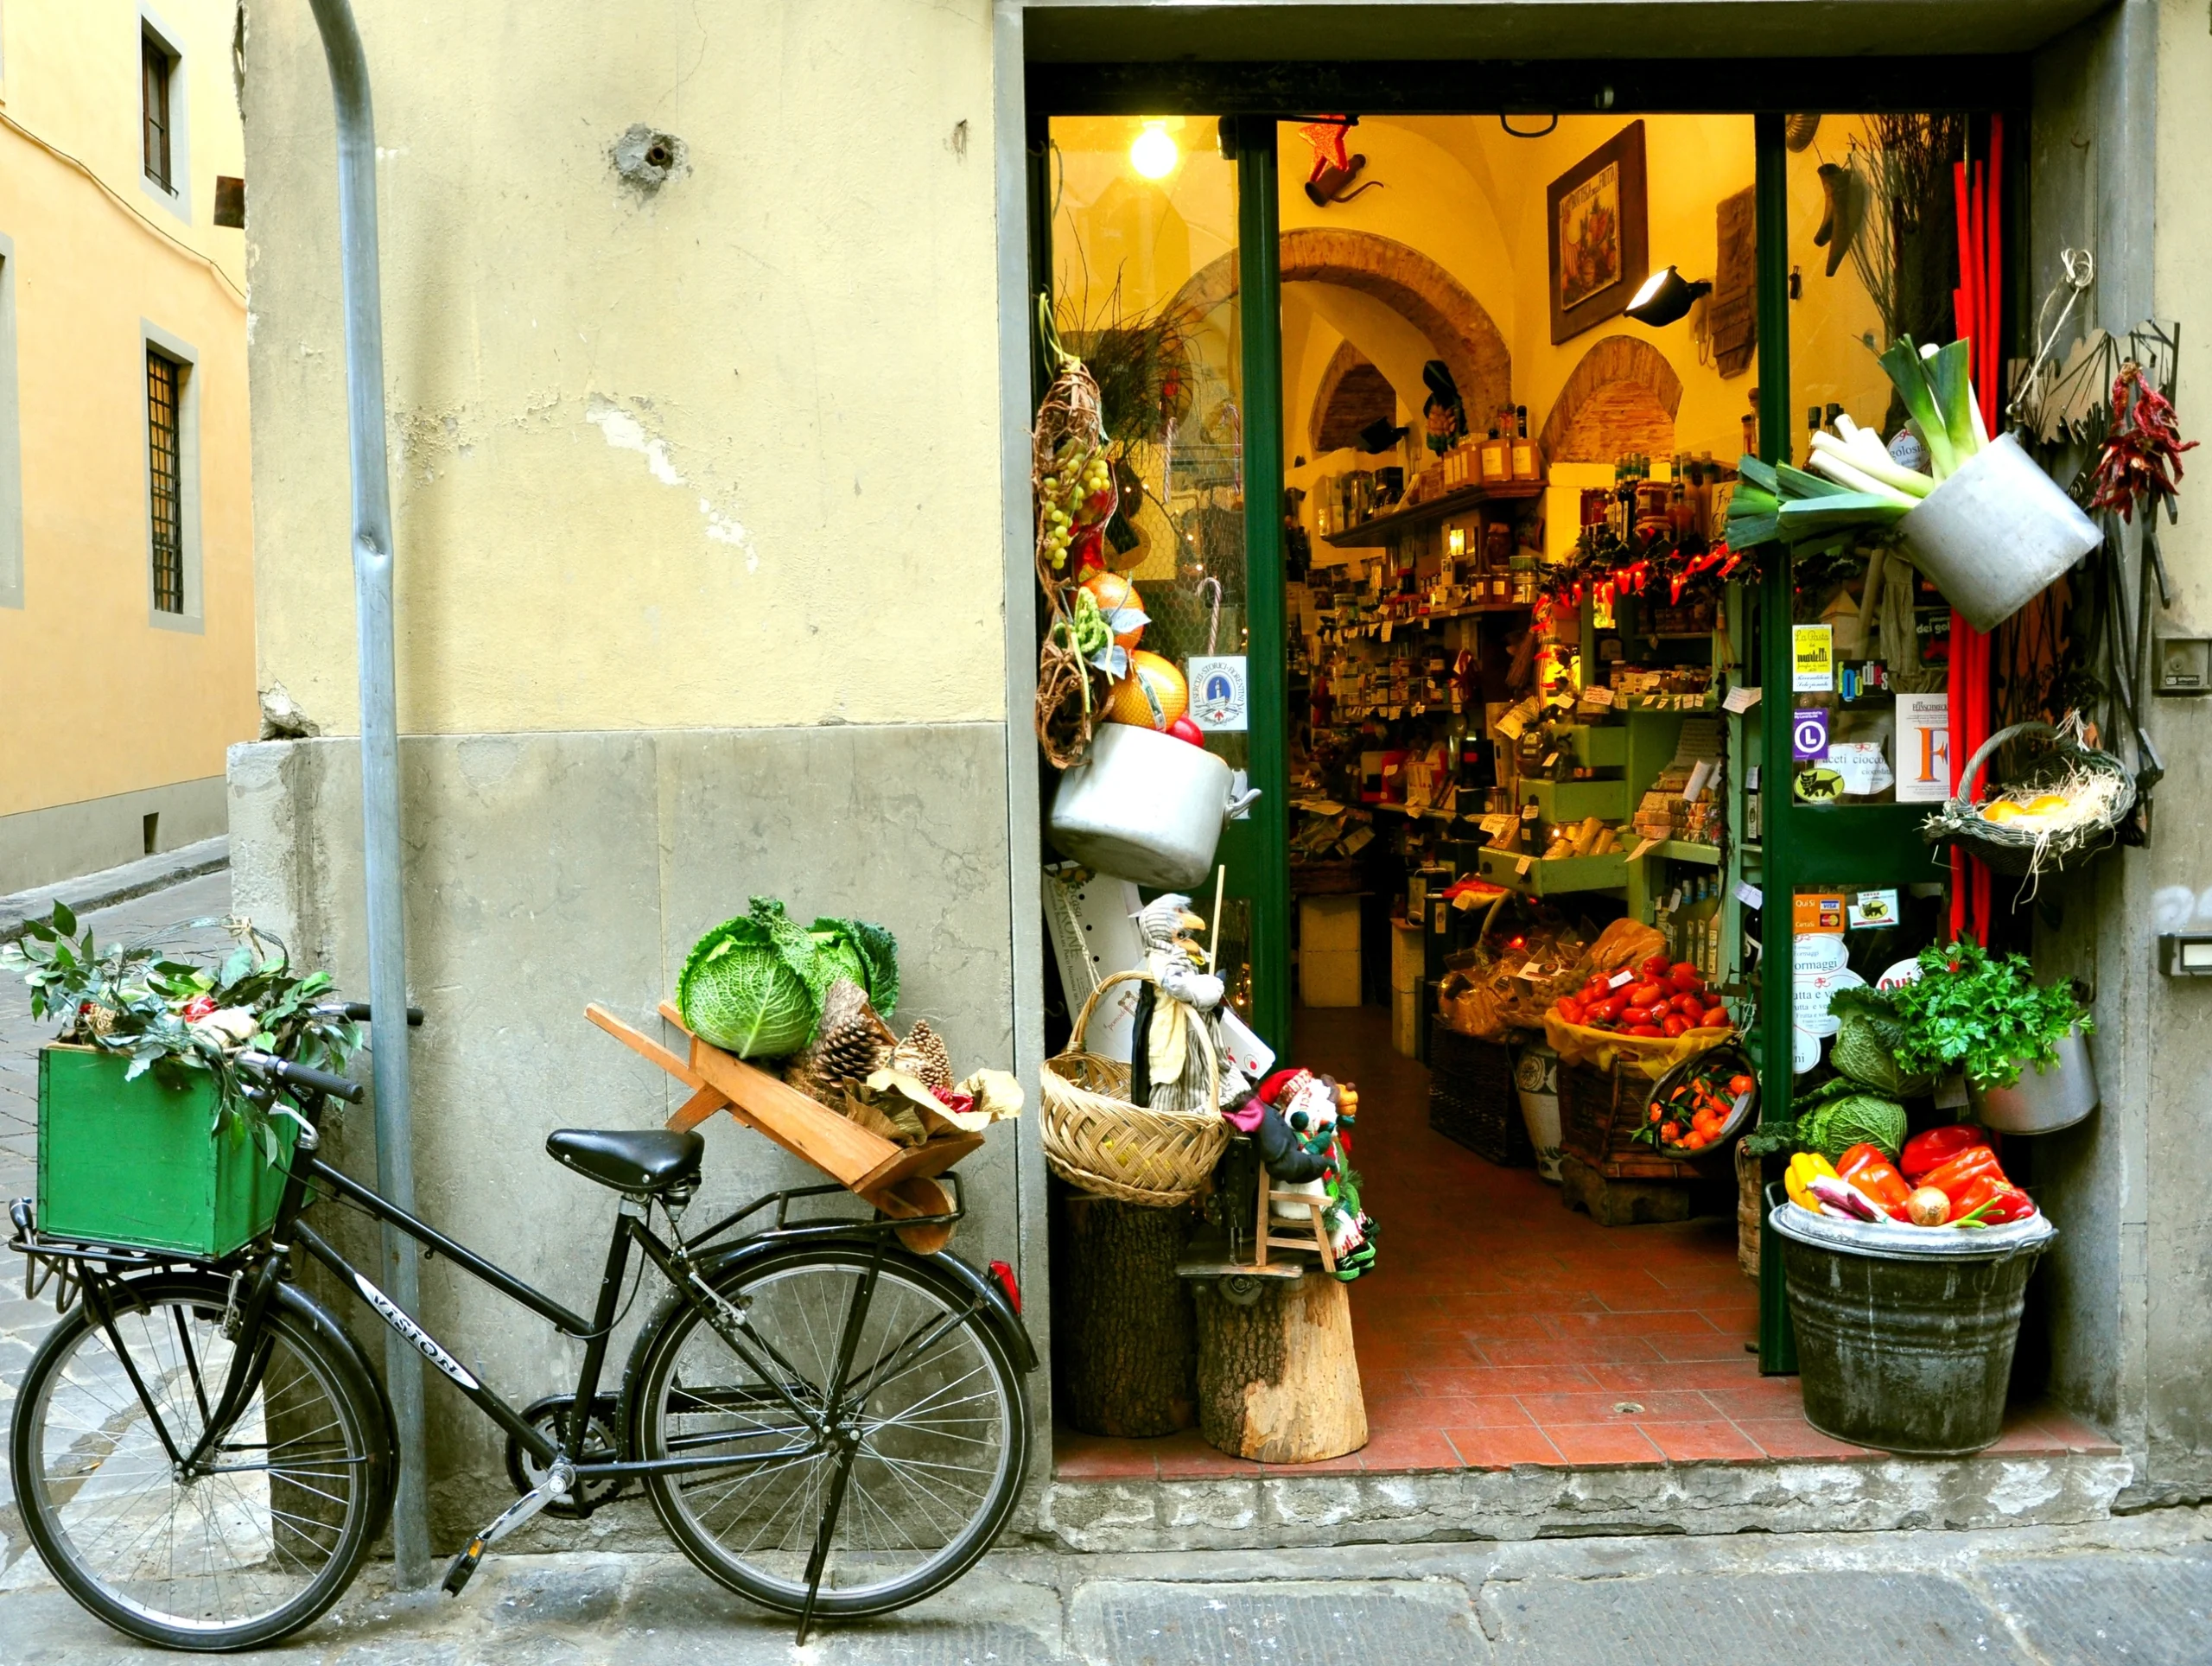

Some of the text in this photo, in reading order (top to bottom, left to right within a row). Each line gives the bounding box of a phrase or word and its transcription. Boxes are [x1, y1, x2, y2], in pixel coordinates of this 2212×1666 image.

[1808, 630, 1829, 640] Pasta
[1916, 623, 1932, 633] dei
[1797, 648, 1828, 662] martelli
[1192, 662, 1245, 703] ESERCIZI STORICI FIORENTINI
[1805, 728, 1817, 745] L
[1914, 727, 1947, 782] F
[1071, 894, 1082, 917] casa
[1794, 957, 1837, 971] ormaggi
[1794, 1052, 1805, 1063] ni
[372, 1294, 459, 1374] VISION
